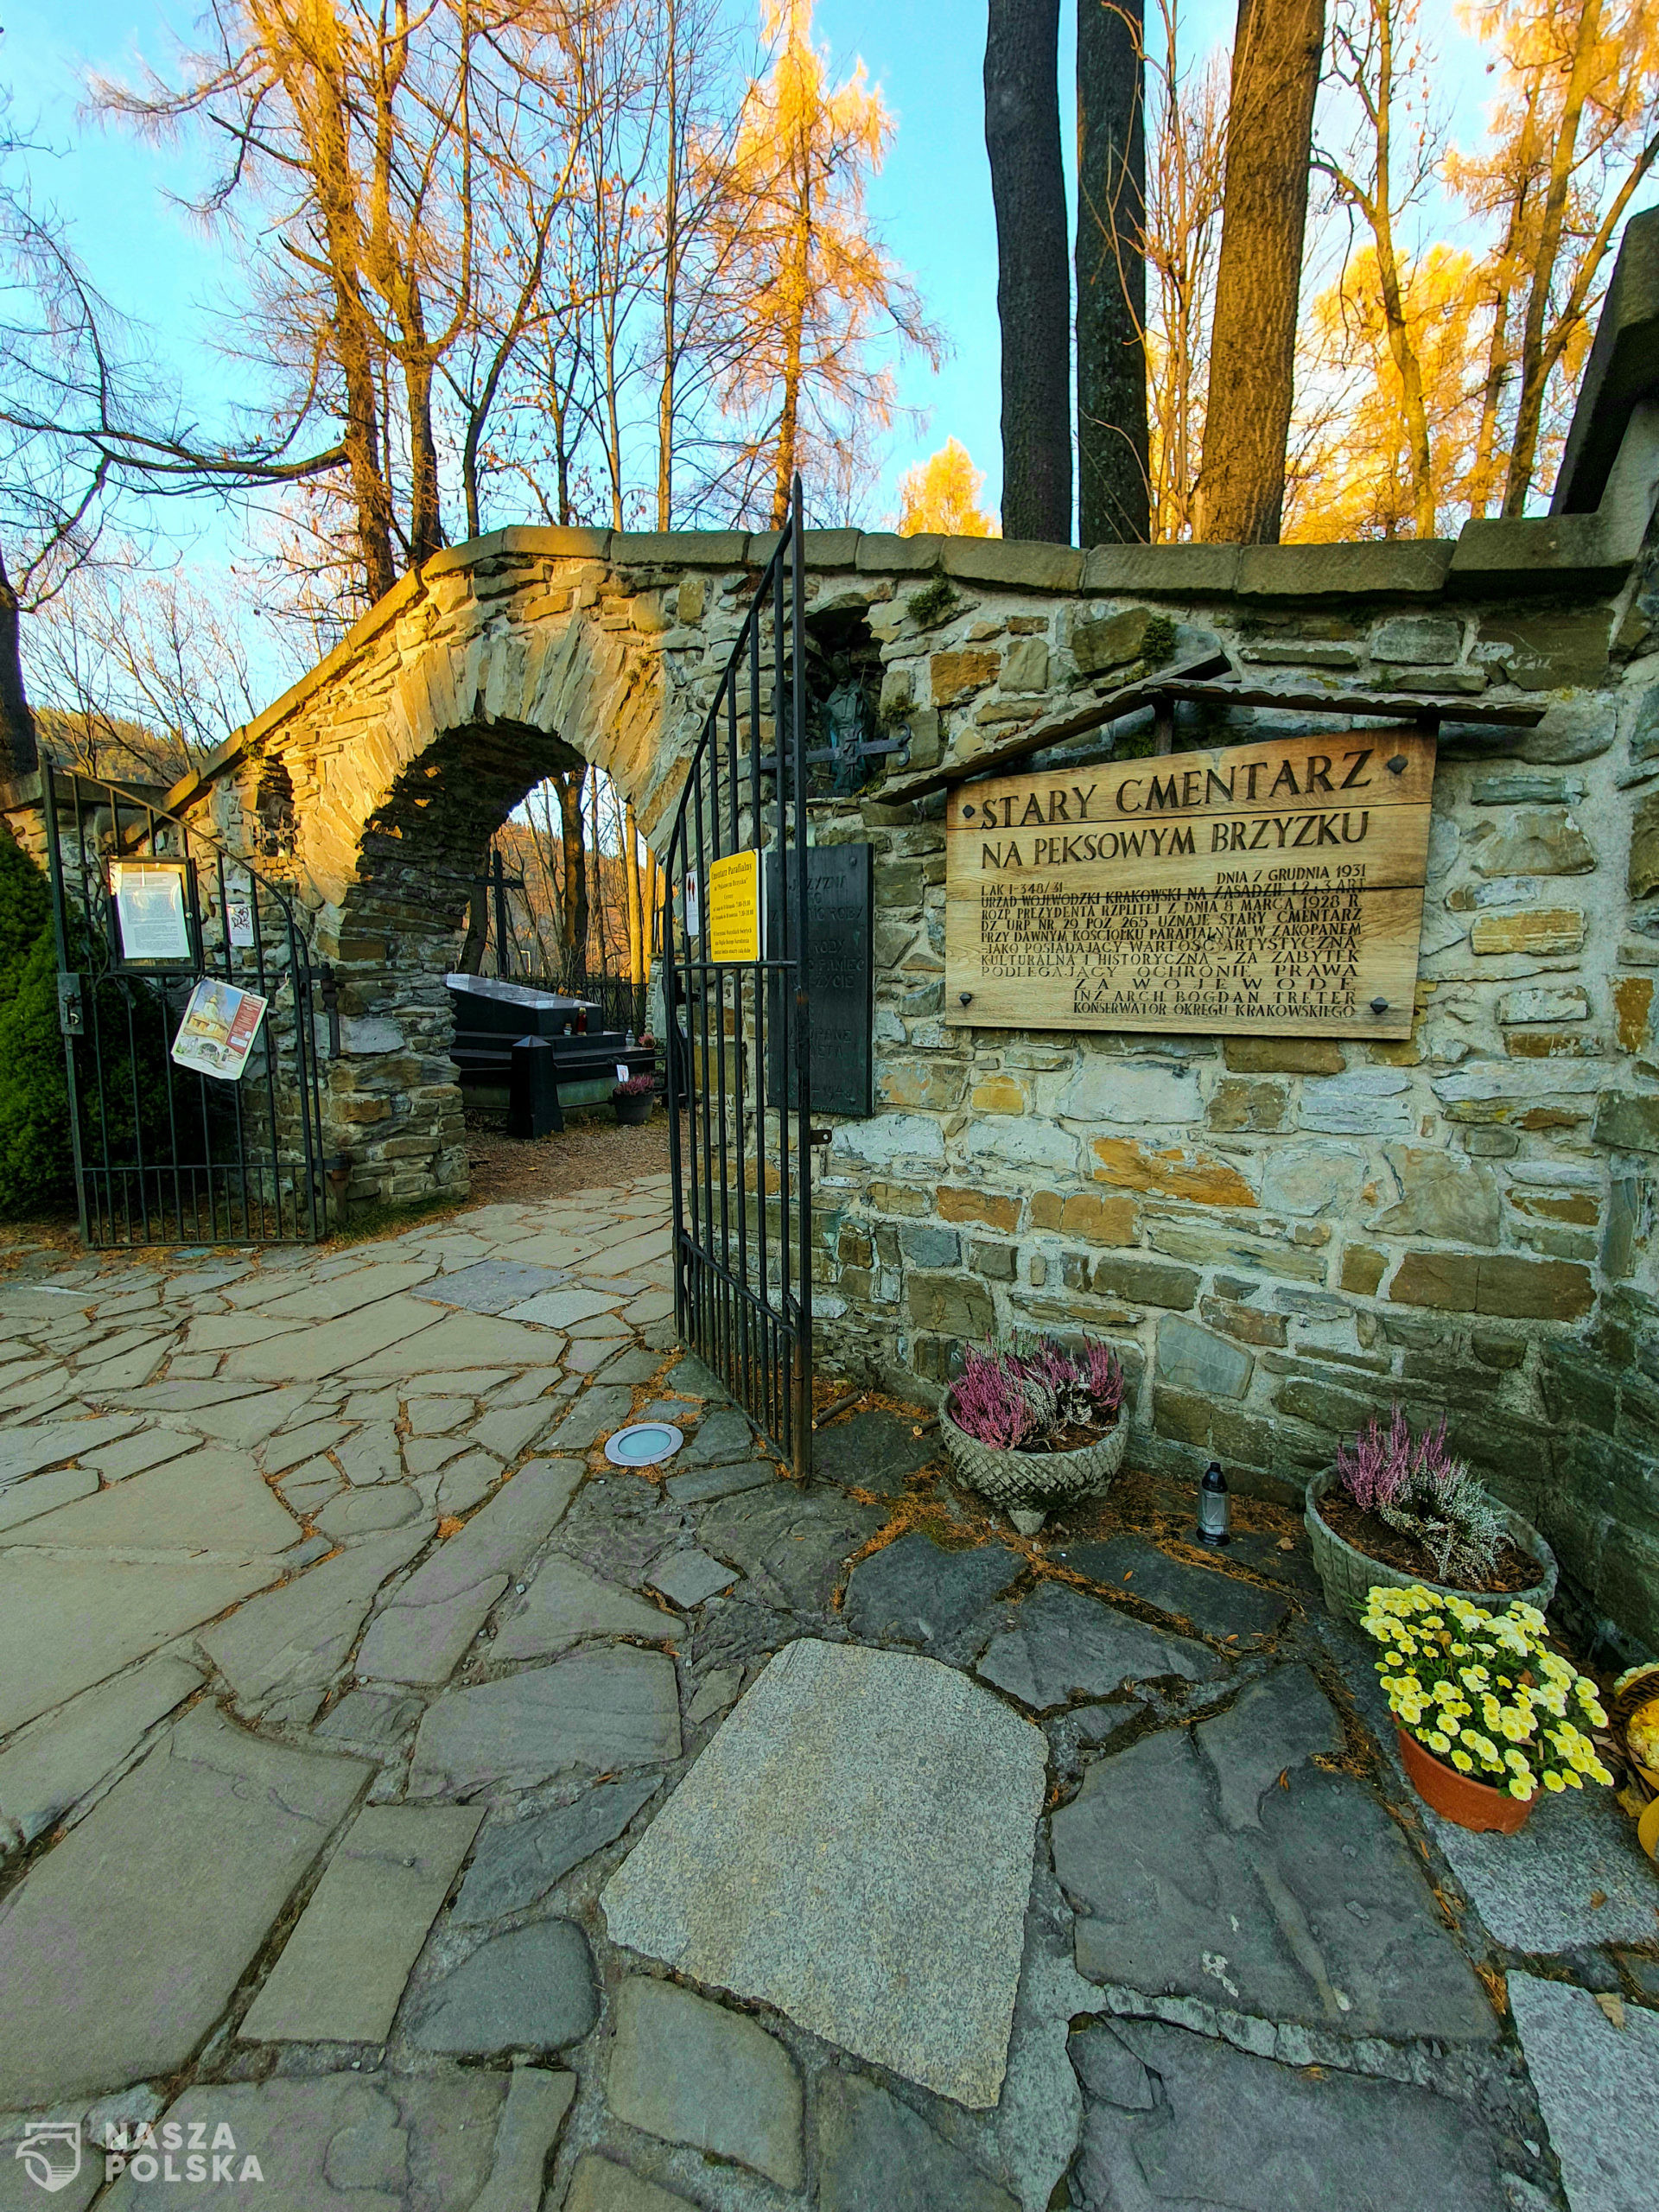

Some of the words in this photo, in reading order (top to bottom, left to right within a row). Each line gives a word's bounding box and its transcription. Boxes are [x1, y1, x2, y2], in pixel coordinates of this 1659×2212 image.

[981, 785, 1097, 830] STARY
[1116, 748, 1374, 813] CMENTARZ
[982, 841, 1023, 868] NA
[1034, 826, 1196, 866] PĘKSOWYM
[1211, 811, 1369, 852] BRZYZKU
[728, 862, 752, 874] Parafialny
[1217, 871, 1248, 885] DNIA
[1268, 866, 1329, 881] GRUDNIA
[1337, 864, 1365, 878] 1931
[1105, 887, 1181, 904] KRAKOWSKI
[1187, 887, 1206, 900] NA
[1214, 881, 1285, 899] ZASADZIE
[1017, 905, 1096, 919] PREZYDENTA
[1102, 903, 1160, 917] RZPLITEJ
[1167, 902, 1177, 914] Z
[1184, 900, 1217, 913] DNIA
[1224, 899, 1233, 912] 8
[1241, 897, 1294, 912] MARCA
[1303, 894, 1339, 909] 1928
[1064, 918, 1078, 929] 29
[1122, 916, 1148, 928] 265
[1159, 914, 1210, 927] UZNAJE
[1219, 911, 1267, 925] STARY
[1277, 907, 1362, 924] CMENTARZ
[982, 931, 1009, 943] PRZY
[1014, 931, 1067, 943] DAWNYM
[1254, 925, 1265, 938] W
[1273, 922, 1361, 937] ZAKOPANEM
[1084, 954, 1089, 965] I
[1235, 951, 1258, 963] ZA
[1271, 950, 1360, 963] ZABYTEK
[1137, 964, 1251, 977] OCHRONIE
[1274, 963, 1358, 976] PRAWA
[1075, 978, 1109, 989] ZA
[1176, 990, 1259, 1003] BOGDAN
[1273, 991, 1356, 1004] TRETER
[1074, 1002, 1166, 1015] KONSERWATOR
[1236, 1004, 1356, 1018] KRAKOWSKIEGO
